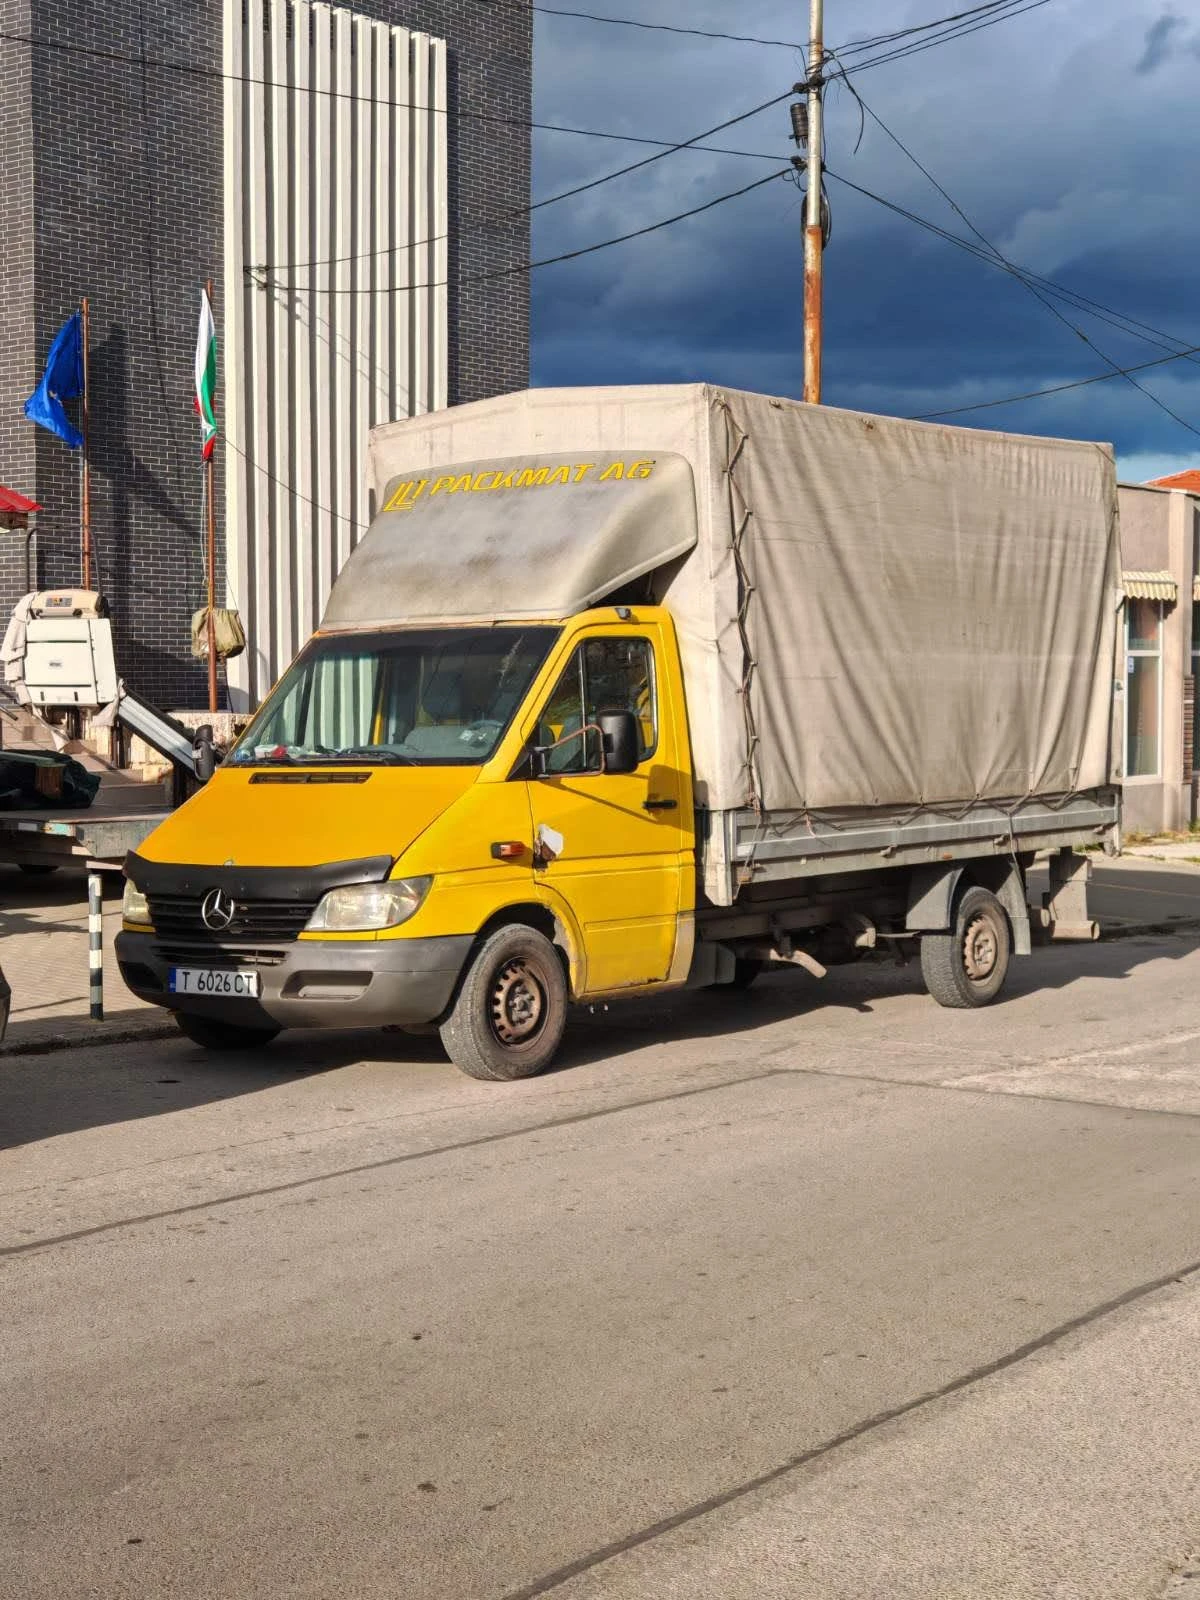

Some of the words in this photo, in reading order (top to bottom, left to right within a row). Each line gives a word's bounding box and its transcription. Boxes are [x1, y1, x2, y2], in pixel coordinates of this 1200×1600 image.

[430, 464, 596, 496] PACKMAT
[599, 460, 656, 482] AG
[182, 971, 190, 991] T
[197, 972, 231, 993] 6026
[234, 974, 253, 994] CT
